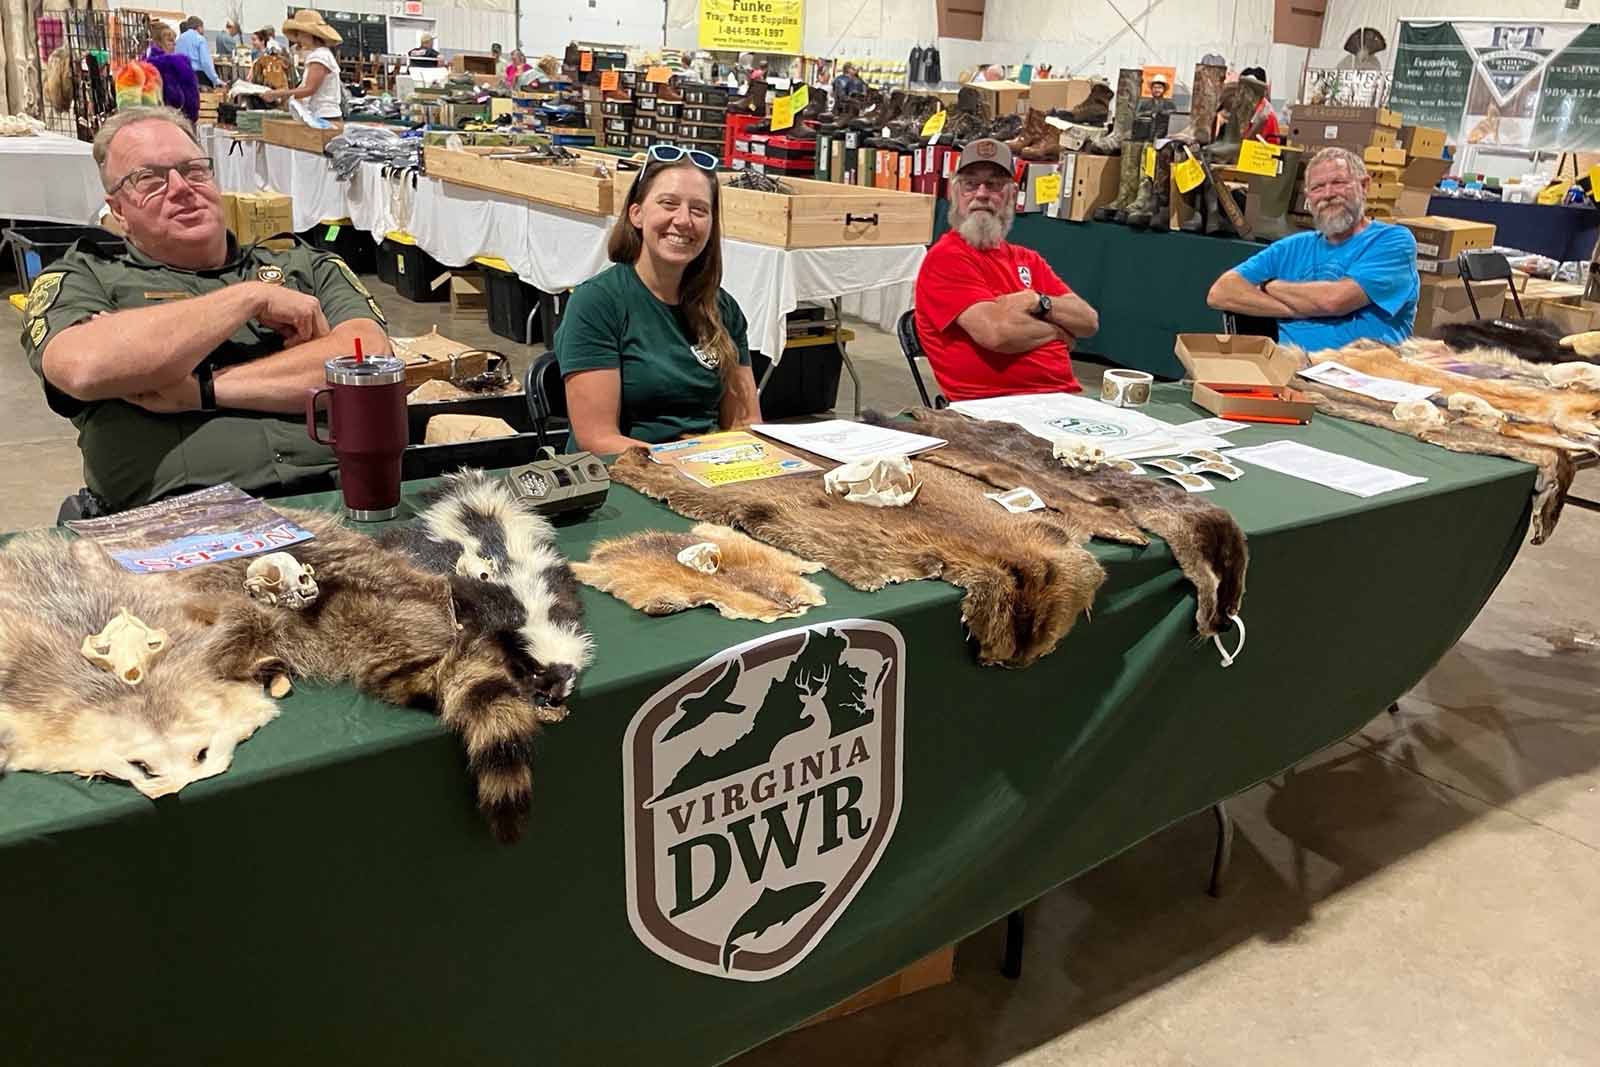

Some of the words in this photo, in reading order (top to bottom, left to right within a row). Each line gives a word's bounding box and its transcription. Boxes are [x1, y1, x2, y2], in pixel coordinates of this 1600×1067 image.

[705, 12, 725, 22] Trap
[728, 13, 750, 24] Tags
[760, 15, 798, 26] Supplies
[732, 0, 772, 13] Funke
[667, 735, 871, 834] VIRGINIA
[668, 776, 873, 919] DWR
